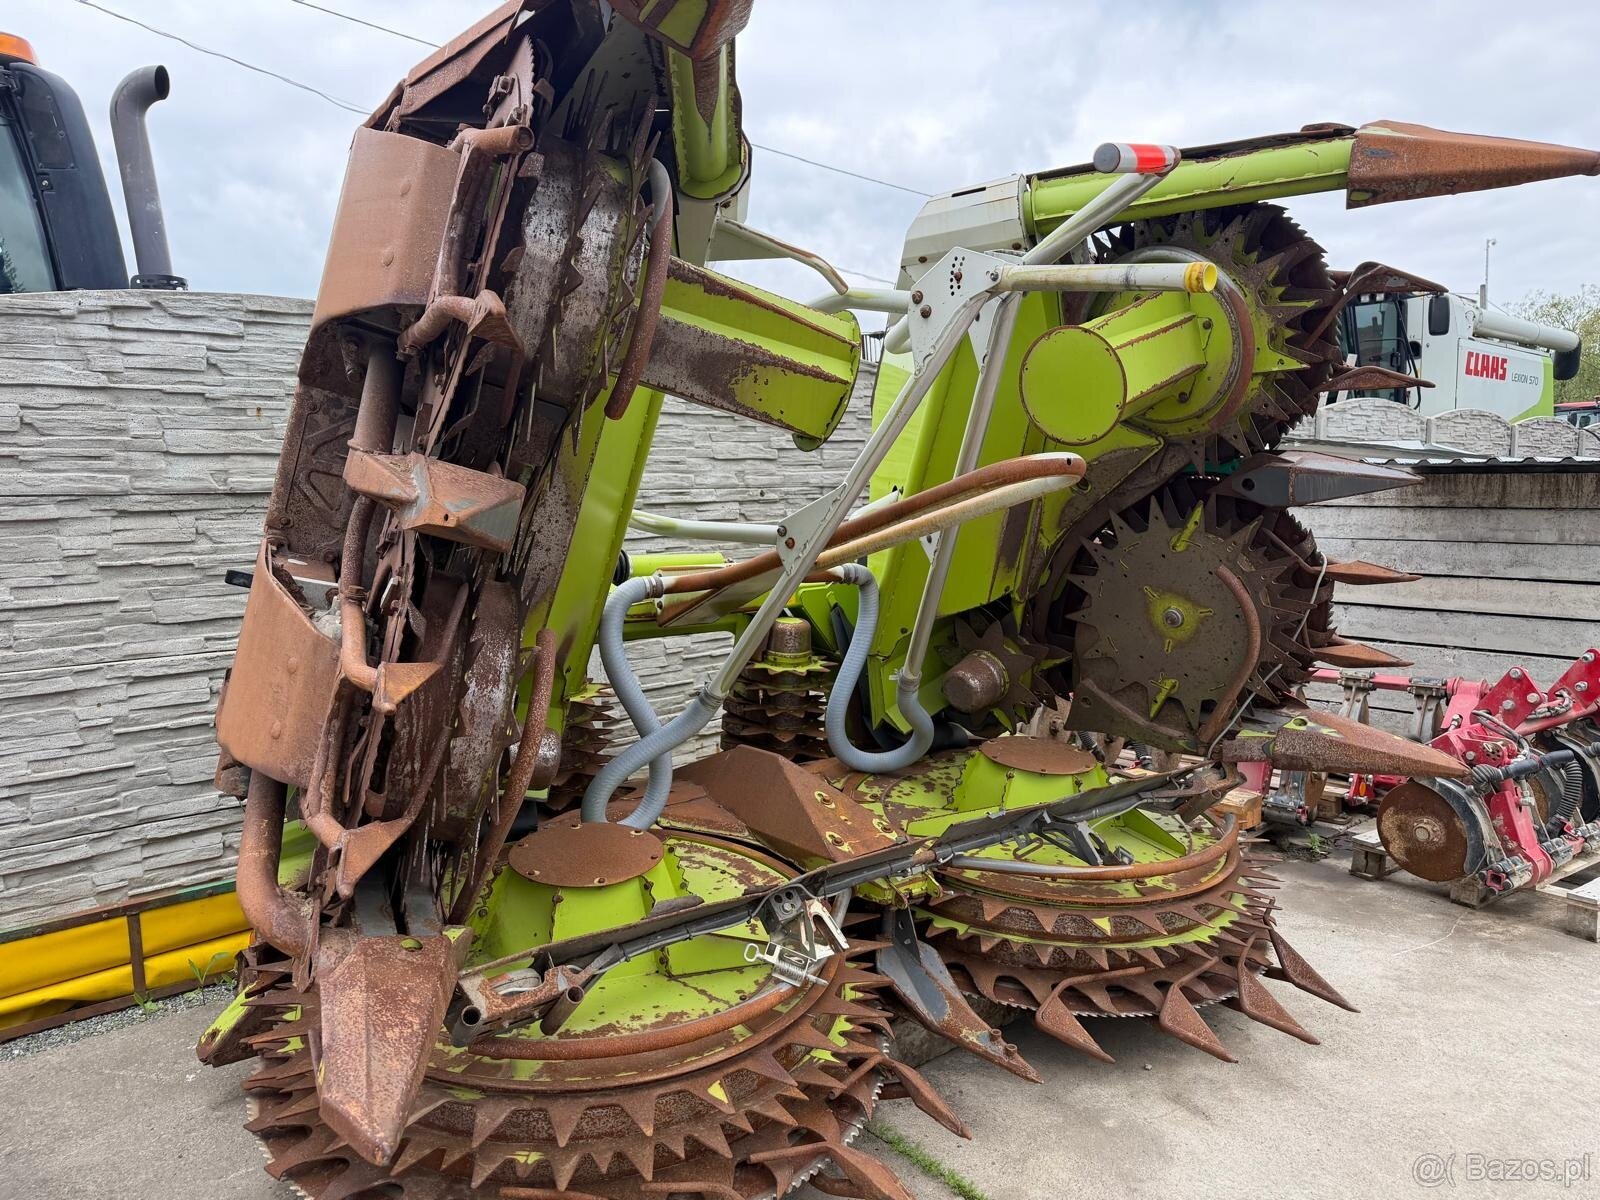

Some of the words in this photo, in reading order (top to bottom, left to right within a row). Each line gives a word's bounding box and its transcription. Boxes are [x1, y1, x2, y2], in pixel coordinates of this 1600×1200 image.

[1465, 351, 1508, 381] CLAAS
[1511, 371, 1528, 384] LEXION
[1528, 375, 1539, 386] 570
